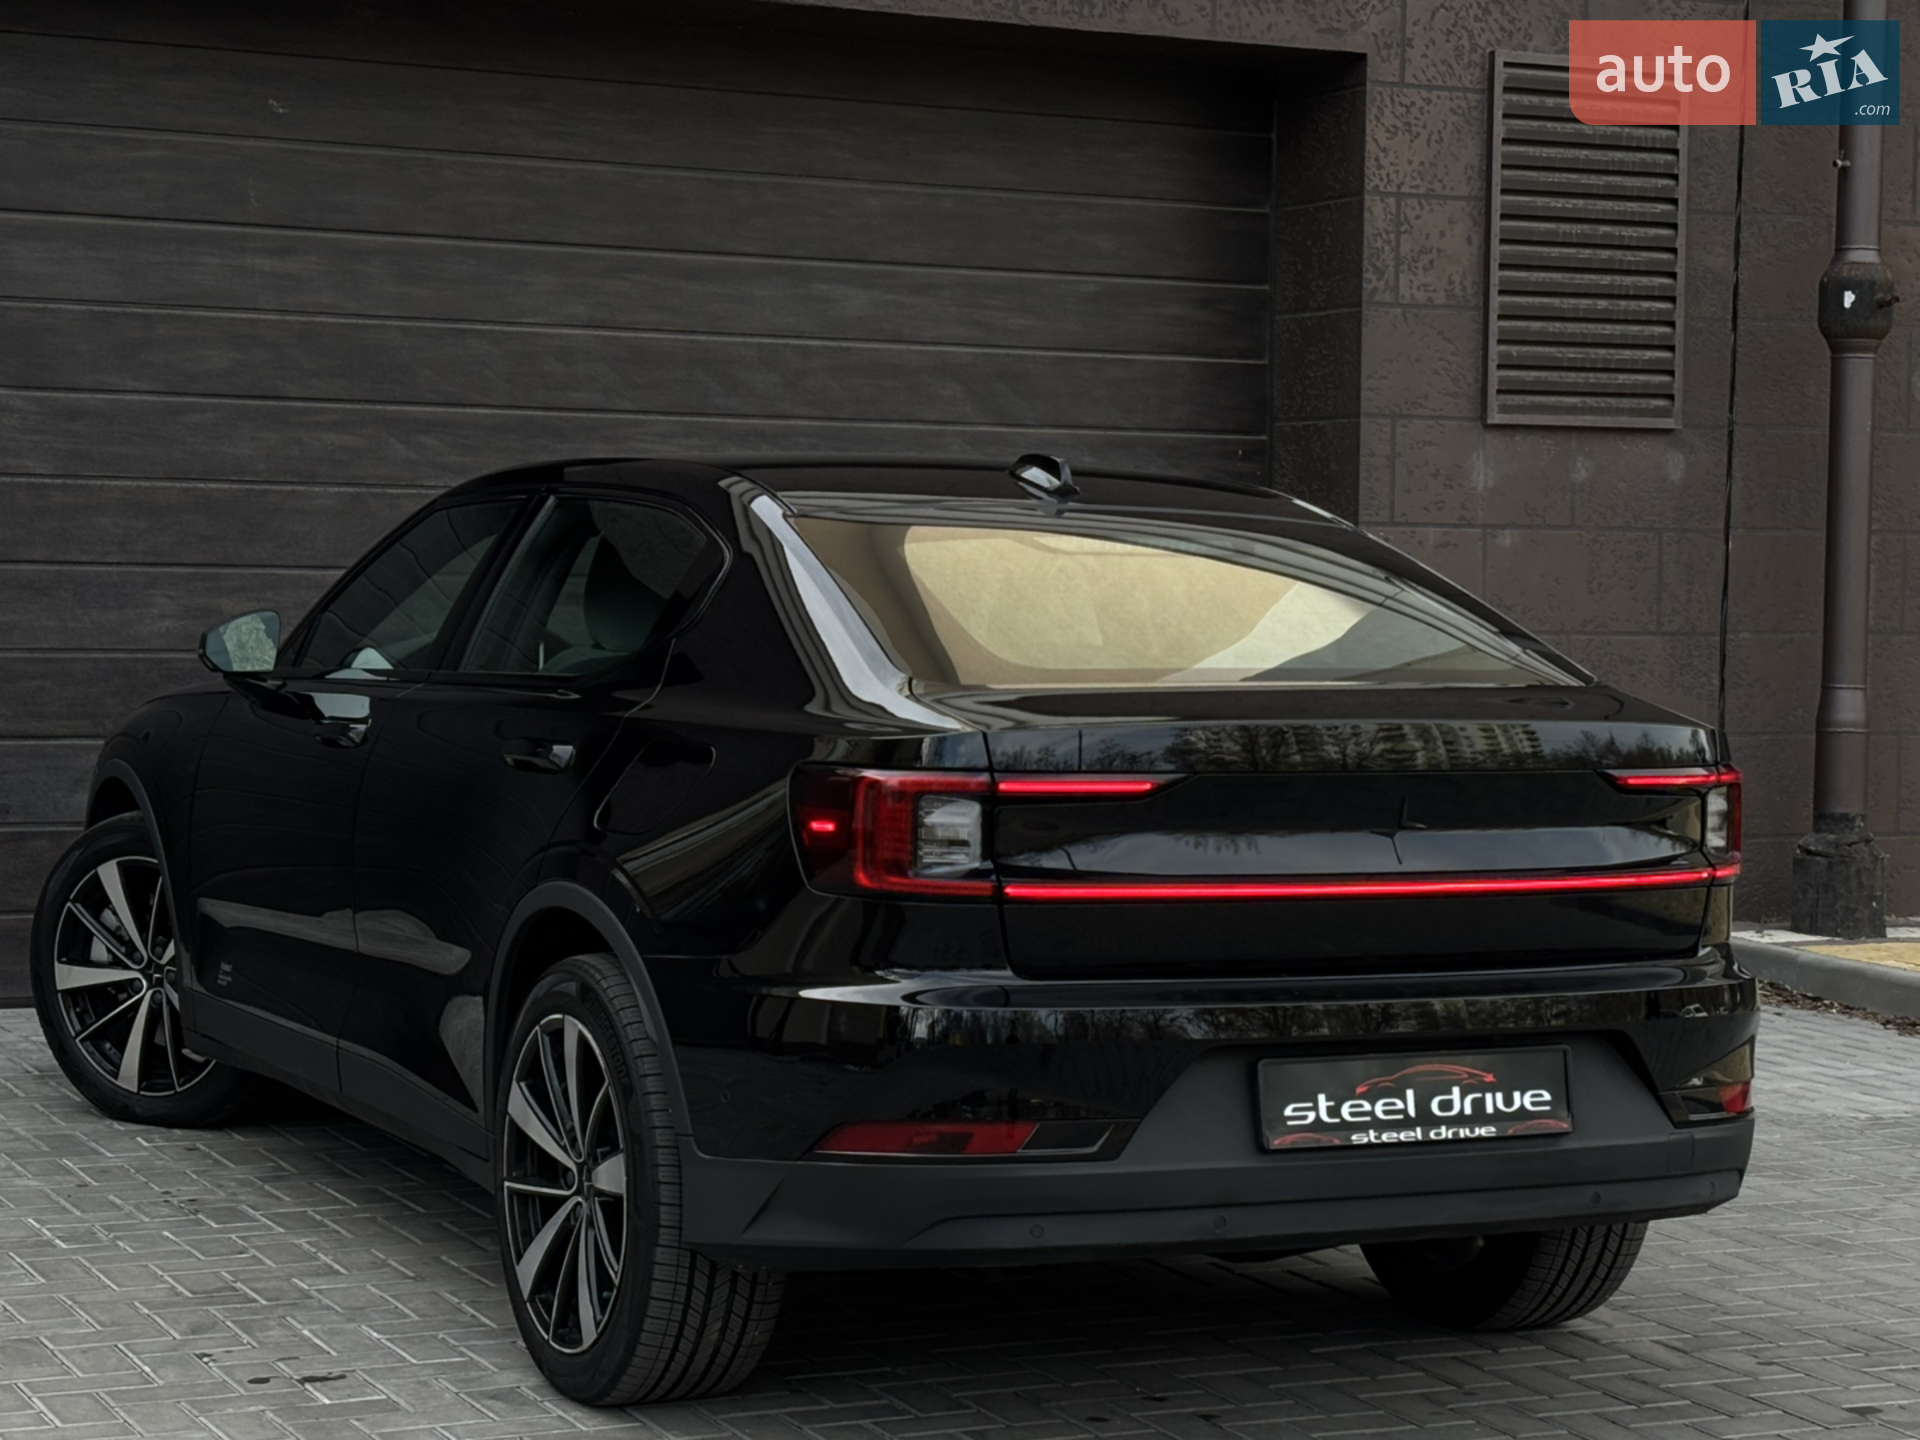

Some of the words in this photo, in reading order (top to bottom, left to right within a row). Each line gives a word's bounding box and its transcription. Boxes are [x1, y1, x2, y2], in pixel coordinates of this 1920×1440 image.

[1283, 1089, 1416, 1126] steel
[1430, 1086, 1553, 1117] drive
[1350, 1127, 1423, 1145] steel
[1428, 1125, 1497, 1140] drive
